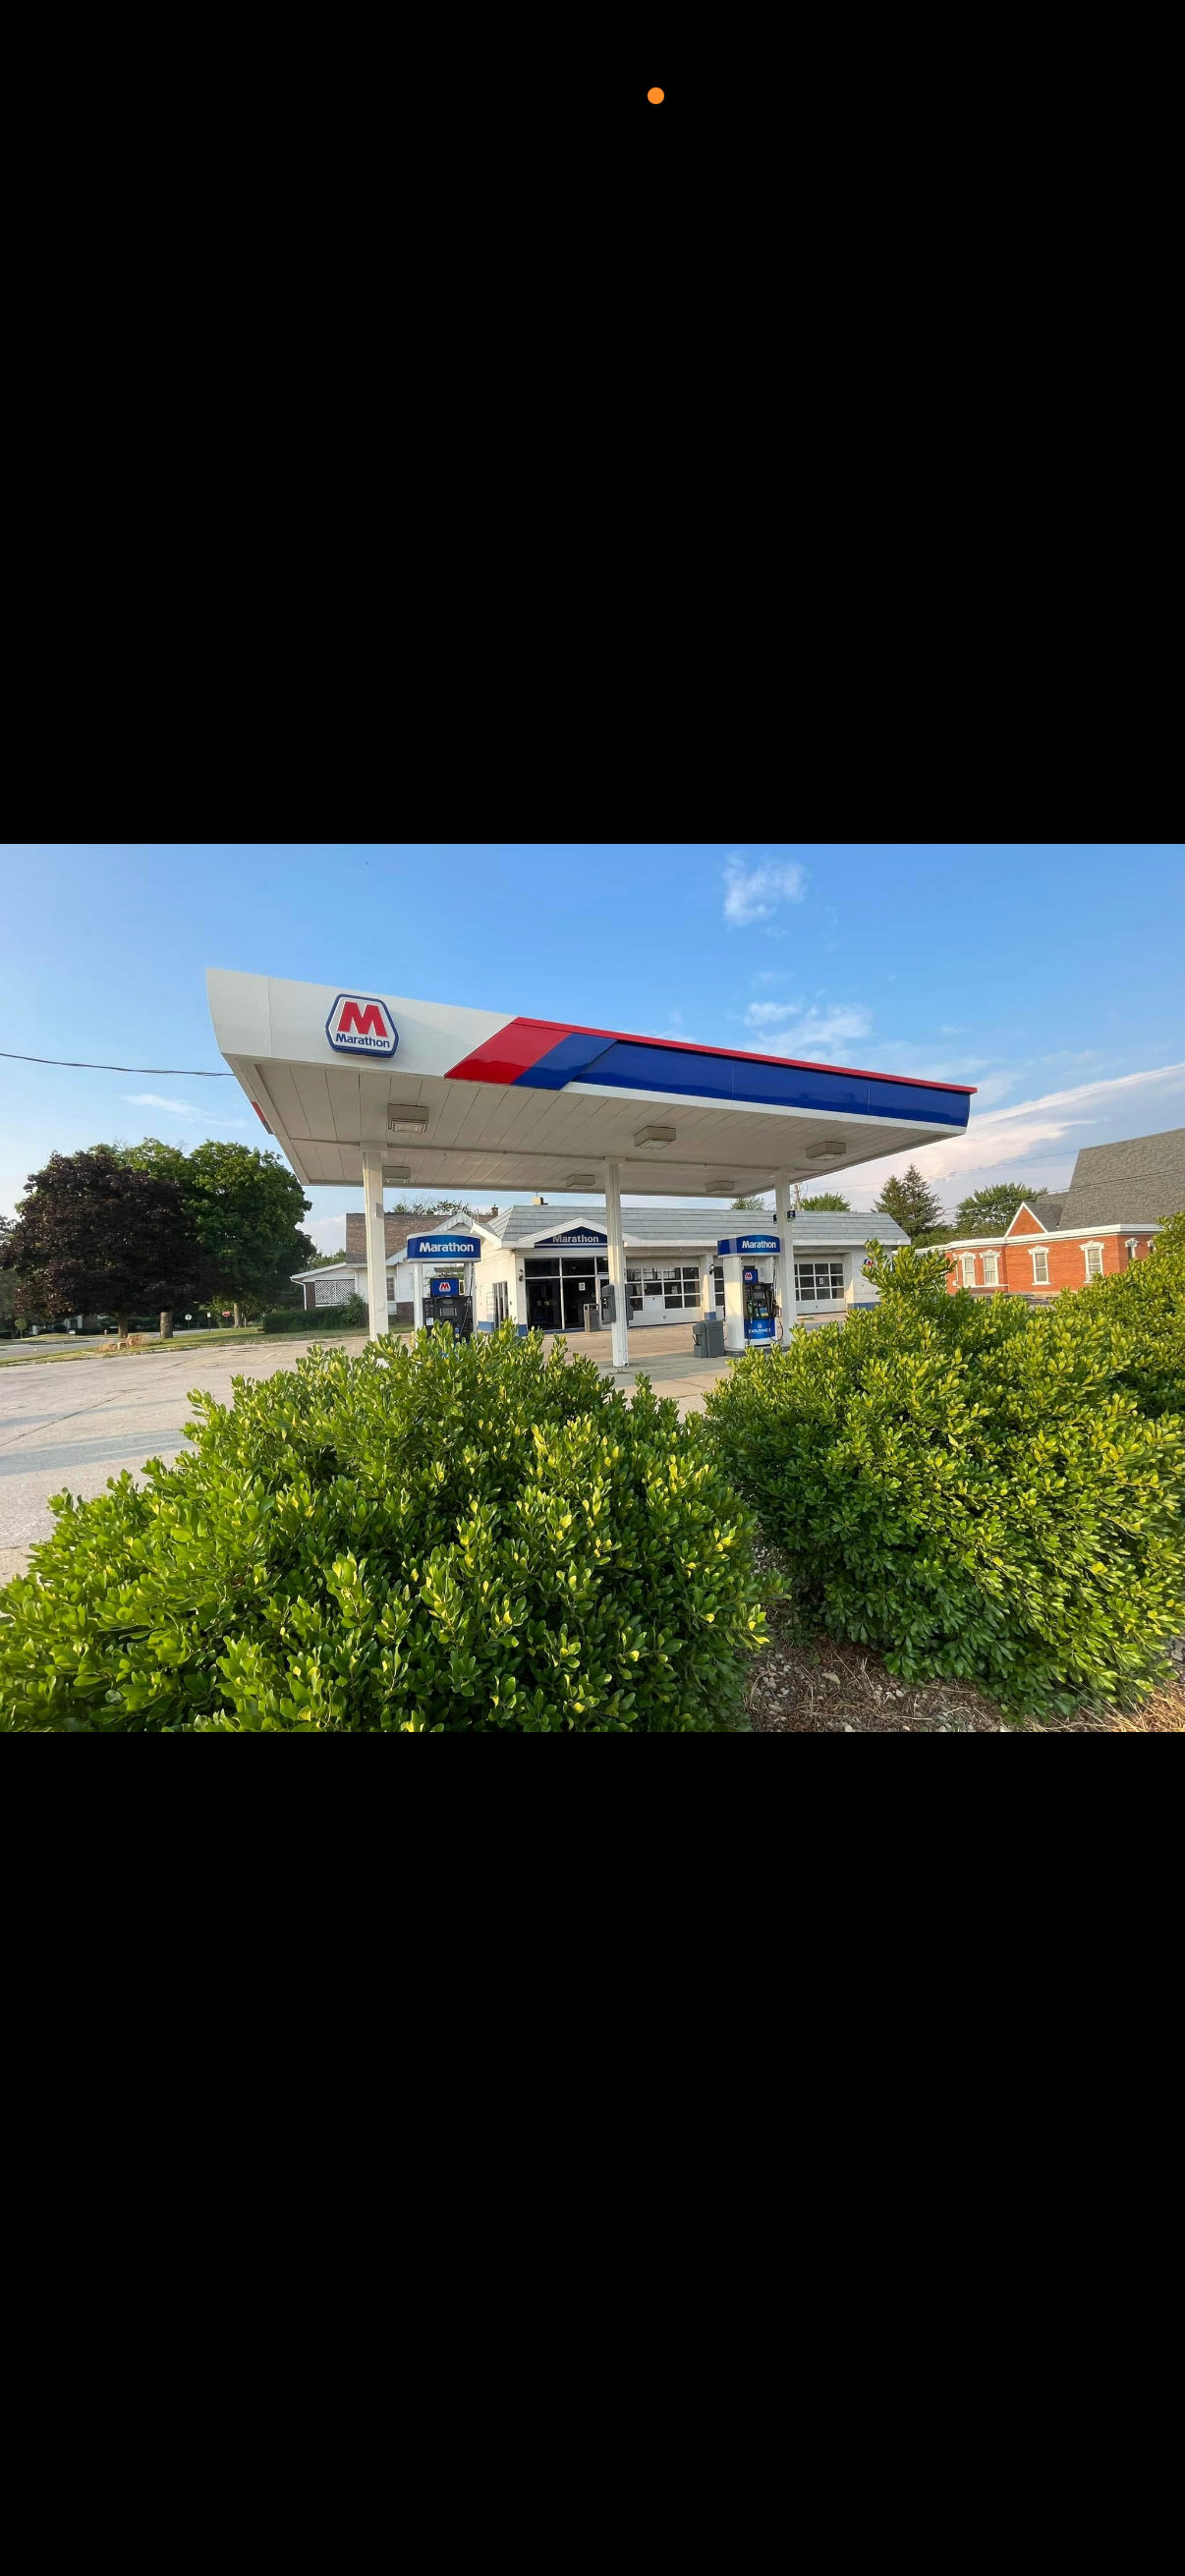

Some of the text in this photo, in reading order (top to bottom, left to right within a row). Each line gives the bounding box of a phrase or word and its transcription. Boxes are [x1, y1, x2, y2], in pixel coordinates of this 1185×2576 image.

[337, 1001, 388, 1037] M
[336, 1034, 390, 1048] Marathon
[552, 1234, 599, 1243] Marathon
[420, 1243, 475, 1253] Marathon
[742, 1240, 777, 1249] Marathon
